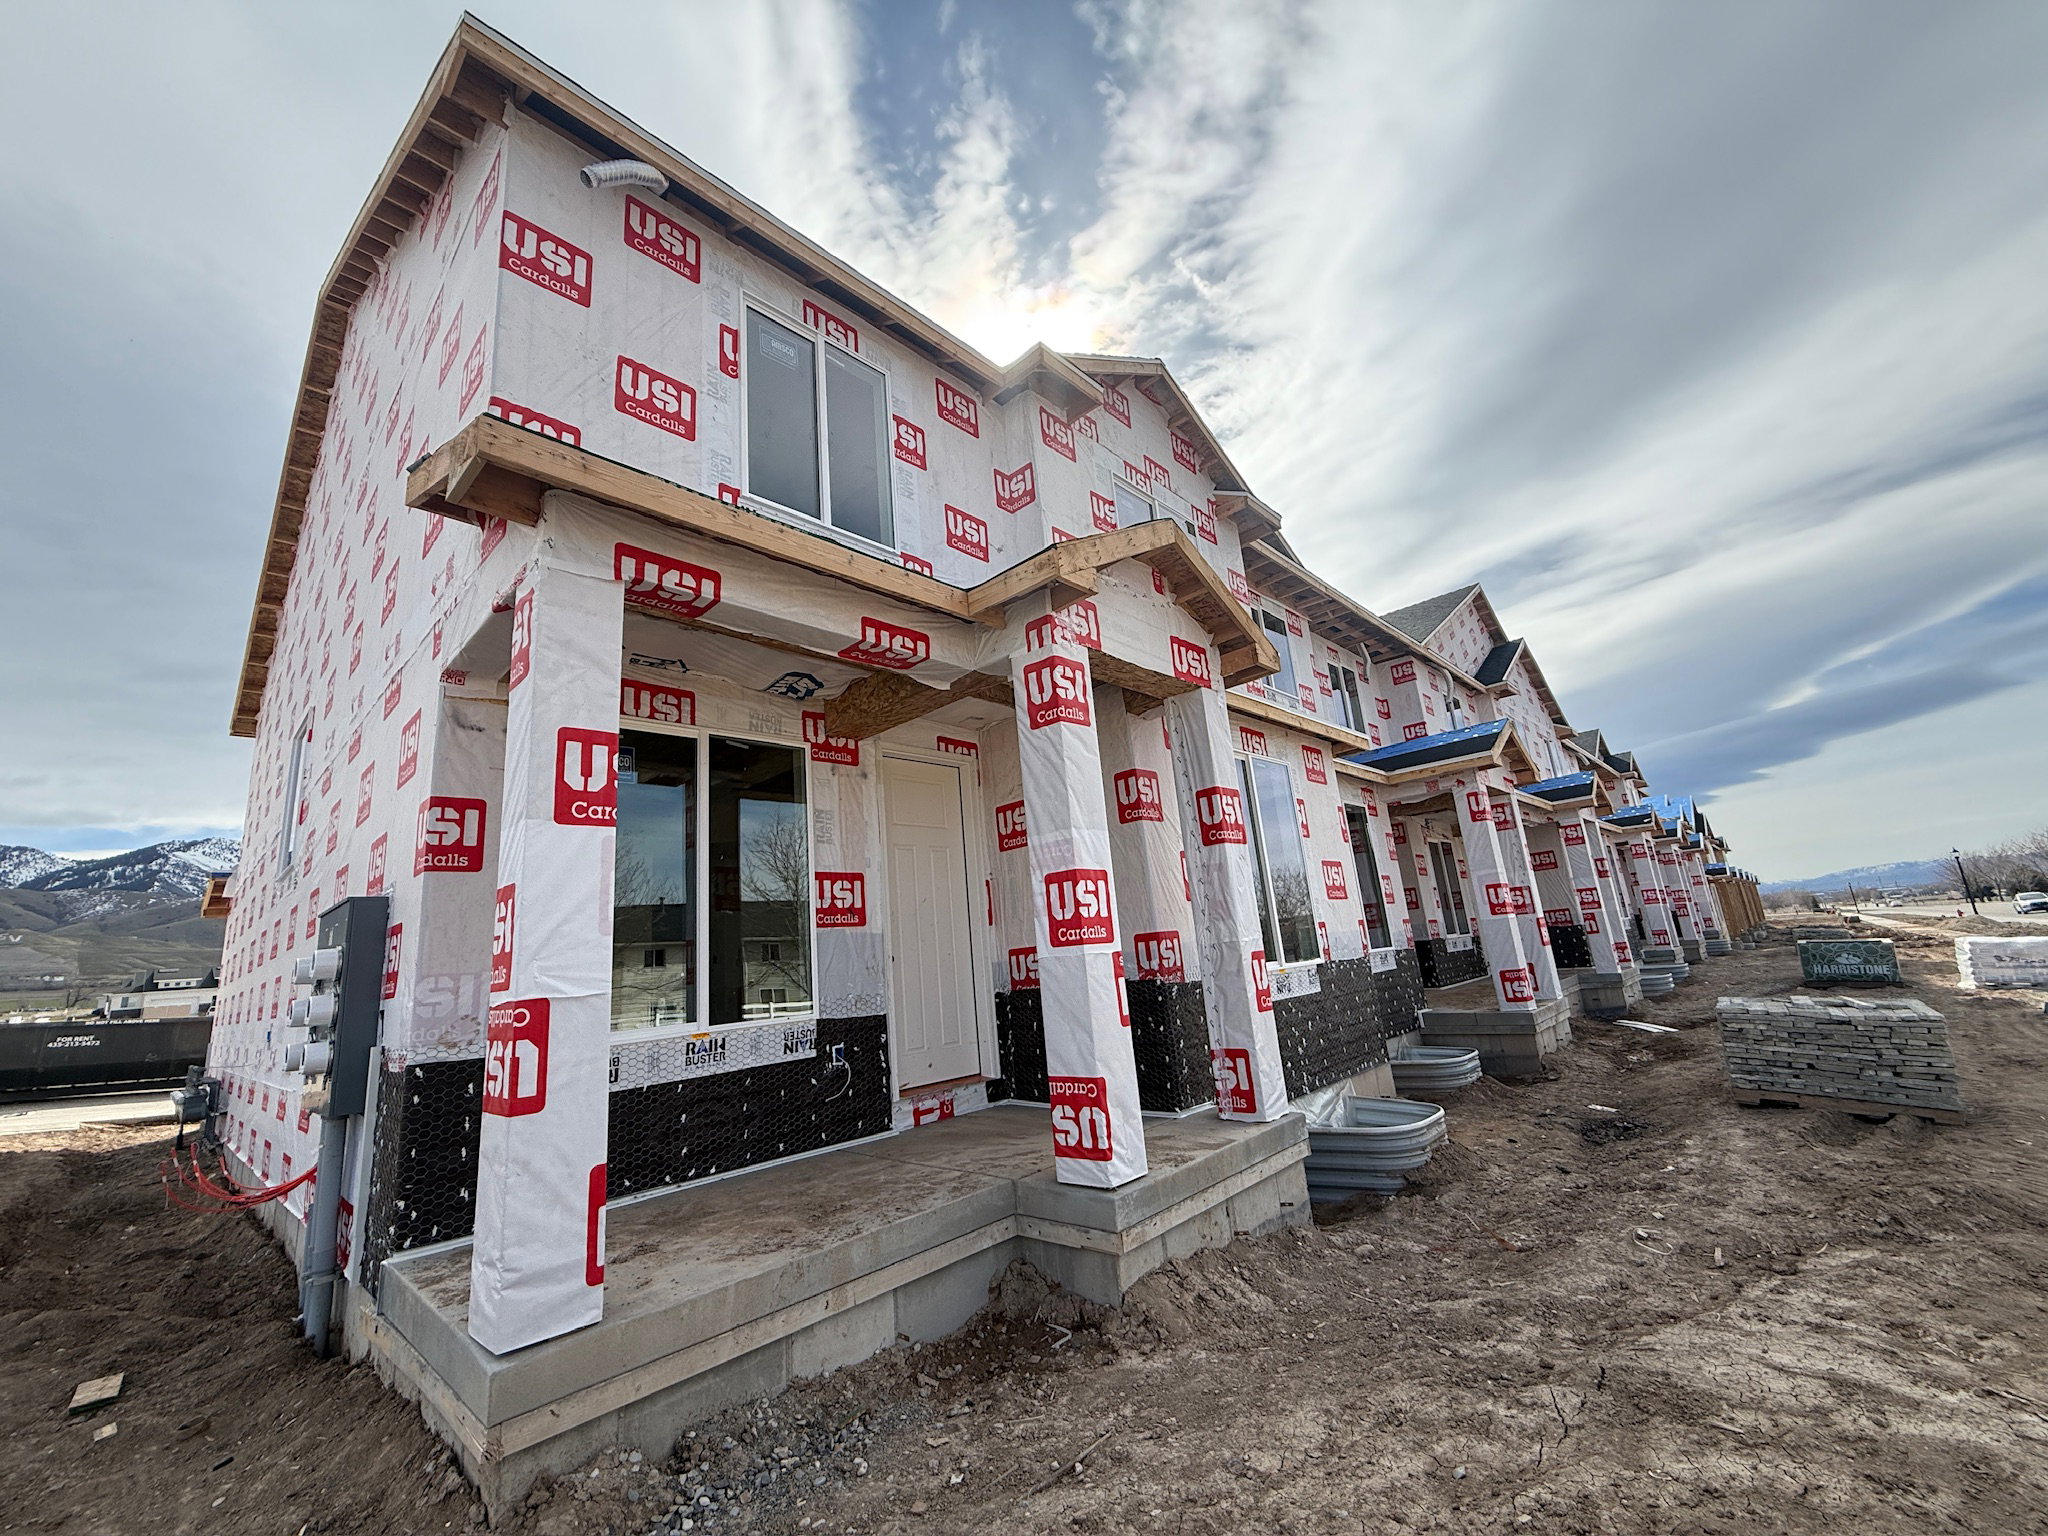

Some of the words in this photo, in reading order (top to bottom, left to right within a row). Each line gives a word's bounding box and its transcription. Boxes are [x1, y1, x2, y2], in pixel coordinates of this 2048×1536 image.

[630, 203, 696, 266] USI
[503, 218, 587, 287] USI
[634, 238, 690, 276] Cardalls
[508, 257, 579, 299] Cardalls
[621, 363, 691, 422] USI
[938, 383, 976, 424] USI
[625, 401, 686, 435] Cardalls
[942, 410, 974, 434] Cardalls
[1041, 412, 1073, 448] USI
[996, 468, 1033, 499] USI
[1001, 494, 1030, 512] Cardalls
[1092, 496, 1115, 525] US
[948, 511, 986, 547] USI
[951, 537, 984, 559] Cardalls
[621, 554, 714, 608] USI
[624, 592, 690, 615] ardalls
[512, 601, 530, 657] SI
[859, 625, 927, 663] USI
[1172, 643, 1209, 680] USI
[1028, 664, 1086, 705] USI
[623, 686, 691, 725] USI
[1036, 705, 1084, 723] Cardalls
[811, 748, 852, 762] Cardalls
[1304, 748, 1325, 771] USI
[1117, 776, 1159, 805] USI
[999, 806, 1027, 835] US
[1125, 807, 1161, 819] Cardalls
[1199, 794, 1243, 826] USI
[417, 806, 479, 849] USI
[1003, 836, 1028, 848] Carda
[1324, 866, 1345, 887] USI
[1049, 879, 1108, 921] USI
[493, 898, 512, 955] SI
[816, 913, 859, 924] Cardalls
[1058, 925, 1107, 942] Cardalls
[1011, 953, 1039, 981] US
[1138, 937, 1181, 971] USI
[1813, 964, 1891, 976] HARRISTONE
[685, 1051, 726, 1067] BUSTER
[686, 1037, 726, 1056] RAIN
[1211, 1057, 1249, 1090] SI
[1052, 1105, 1110, 1150] US
